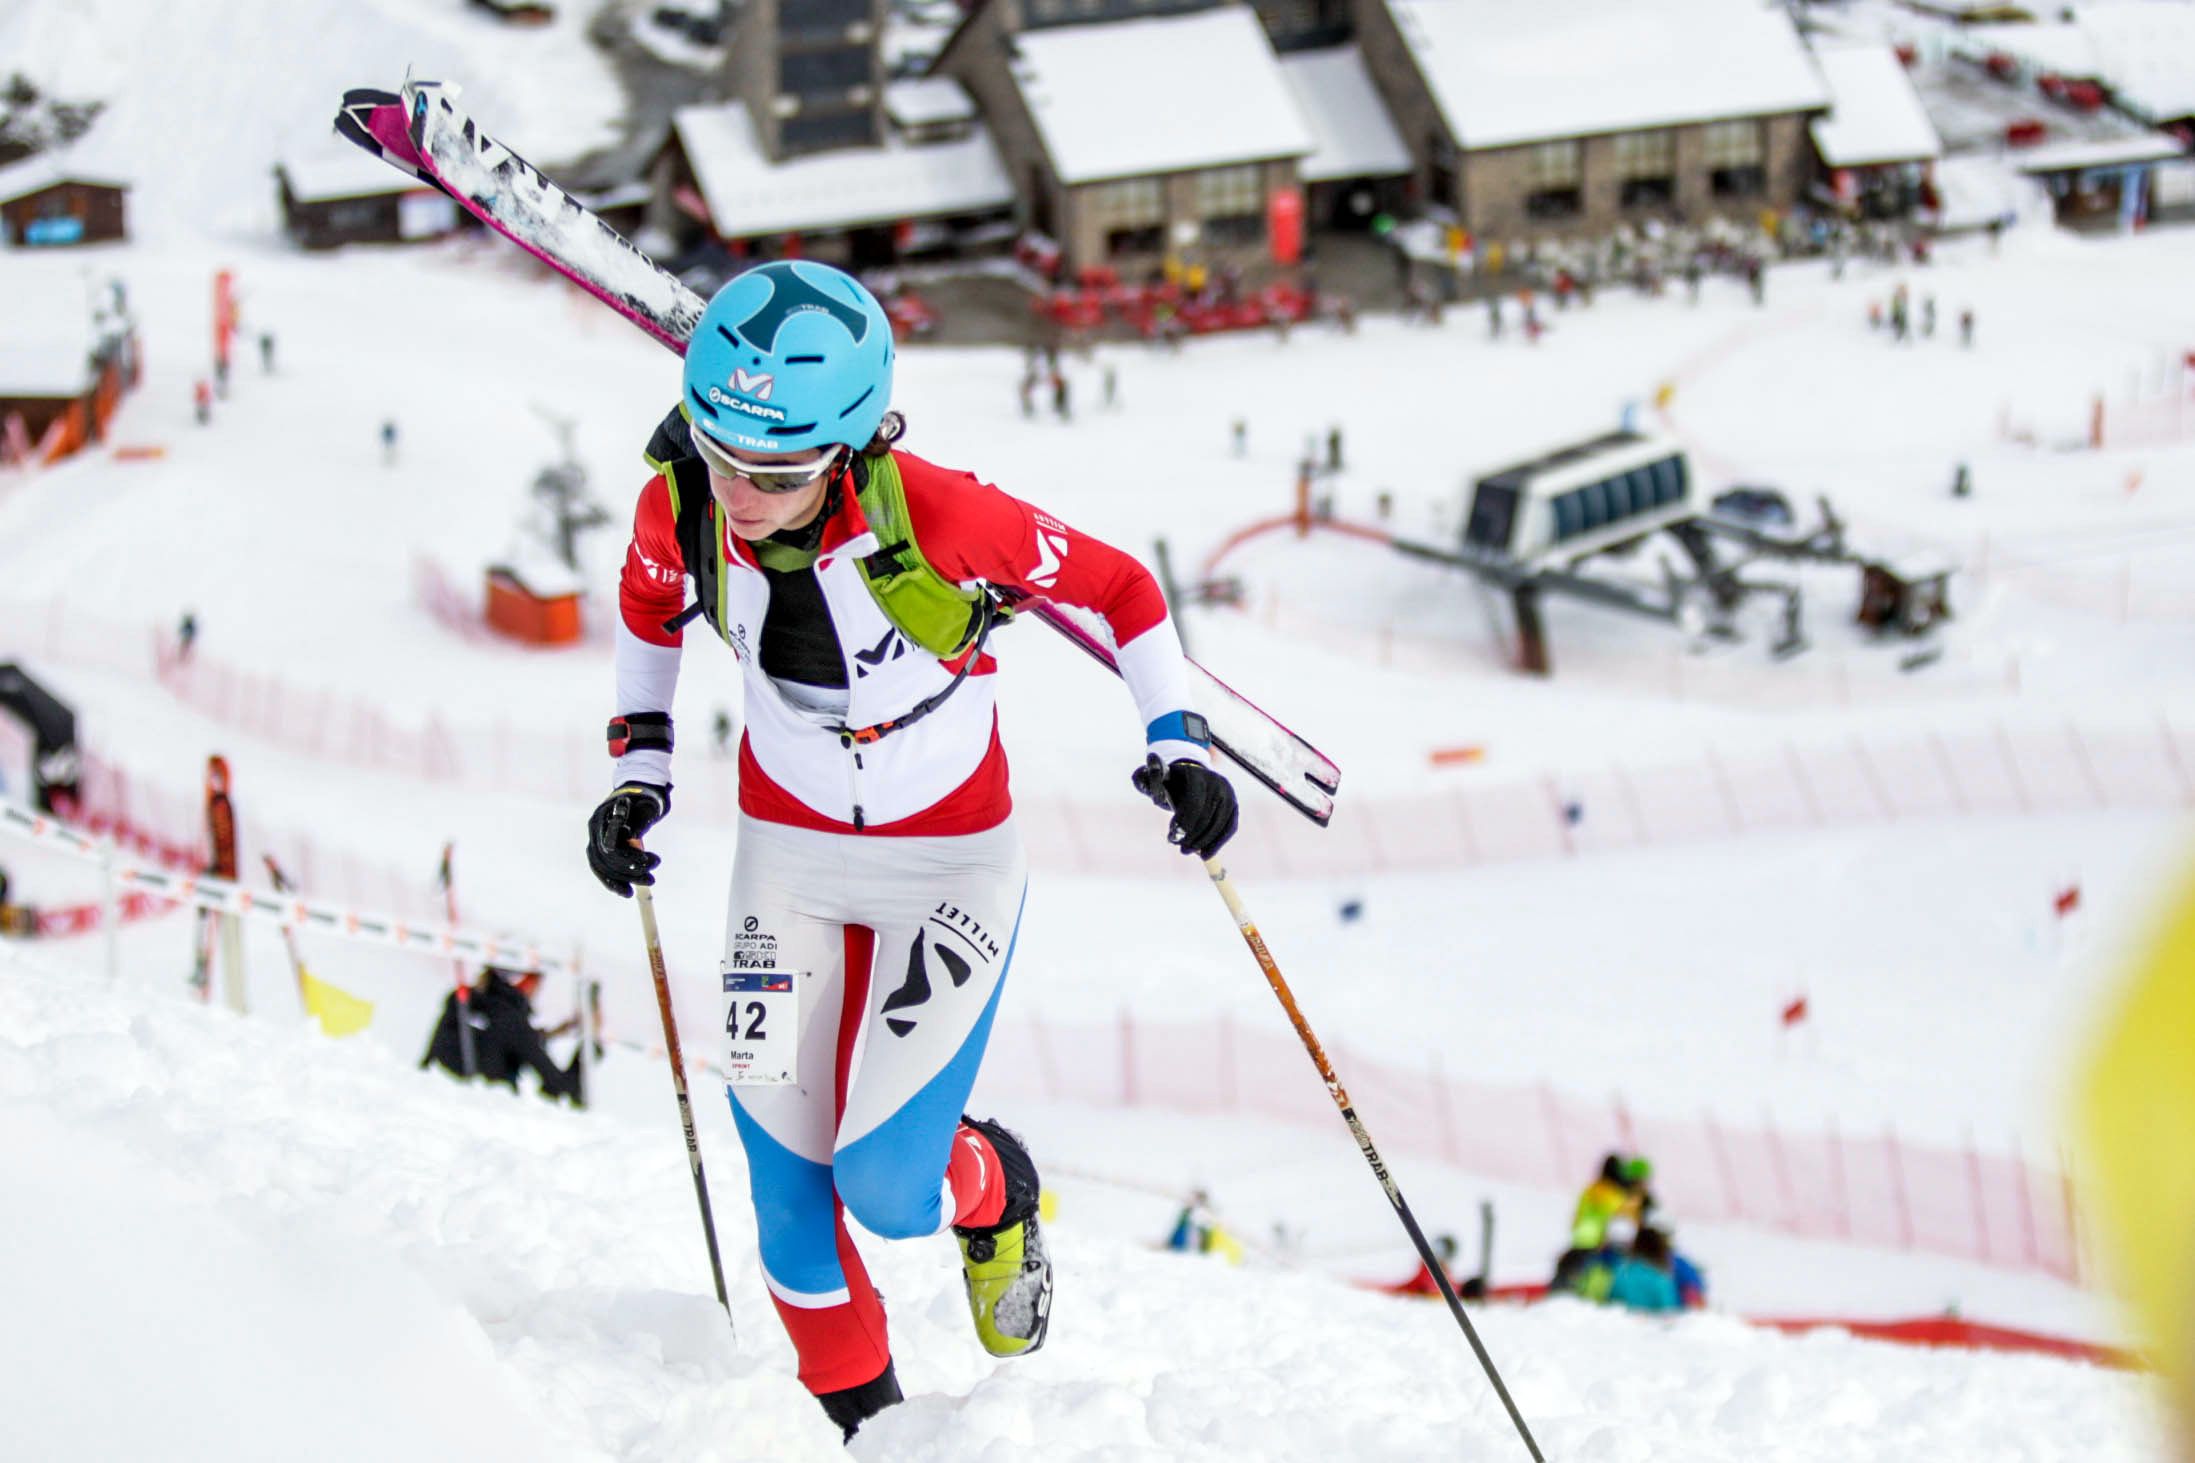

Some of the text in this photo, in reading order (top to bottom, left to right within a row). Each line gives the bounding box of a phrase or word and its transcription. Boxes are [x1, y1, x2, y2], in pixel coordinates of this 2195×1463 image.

[720, 394, 785, 421] SCARPA
[738, 435, 779, 449] TRAB
[935, 901, 999, 957] MILLET
[732, 959, 776, 969] TRAB
[726, 1001, 767, 1040] 42
[730, 1050, 755, 1060] Marta
[1362, 1143, 1388, 1181] TRAB
